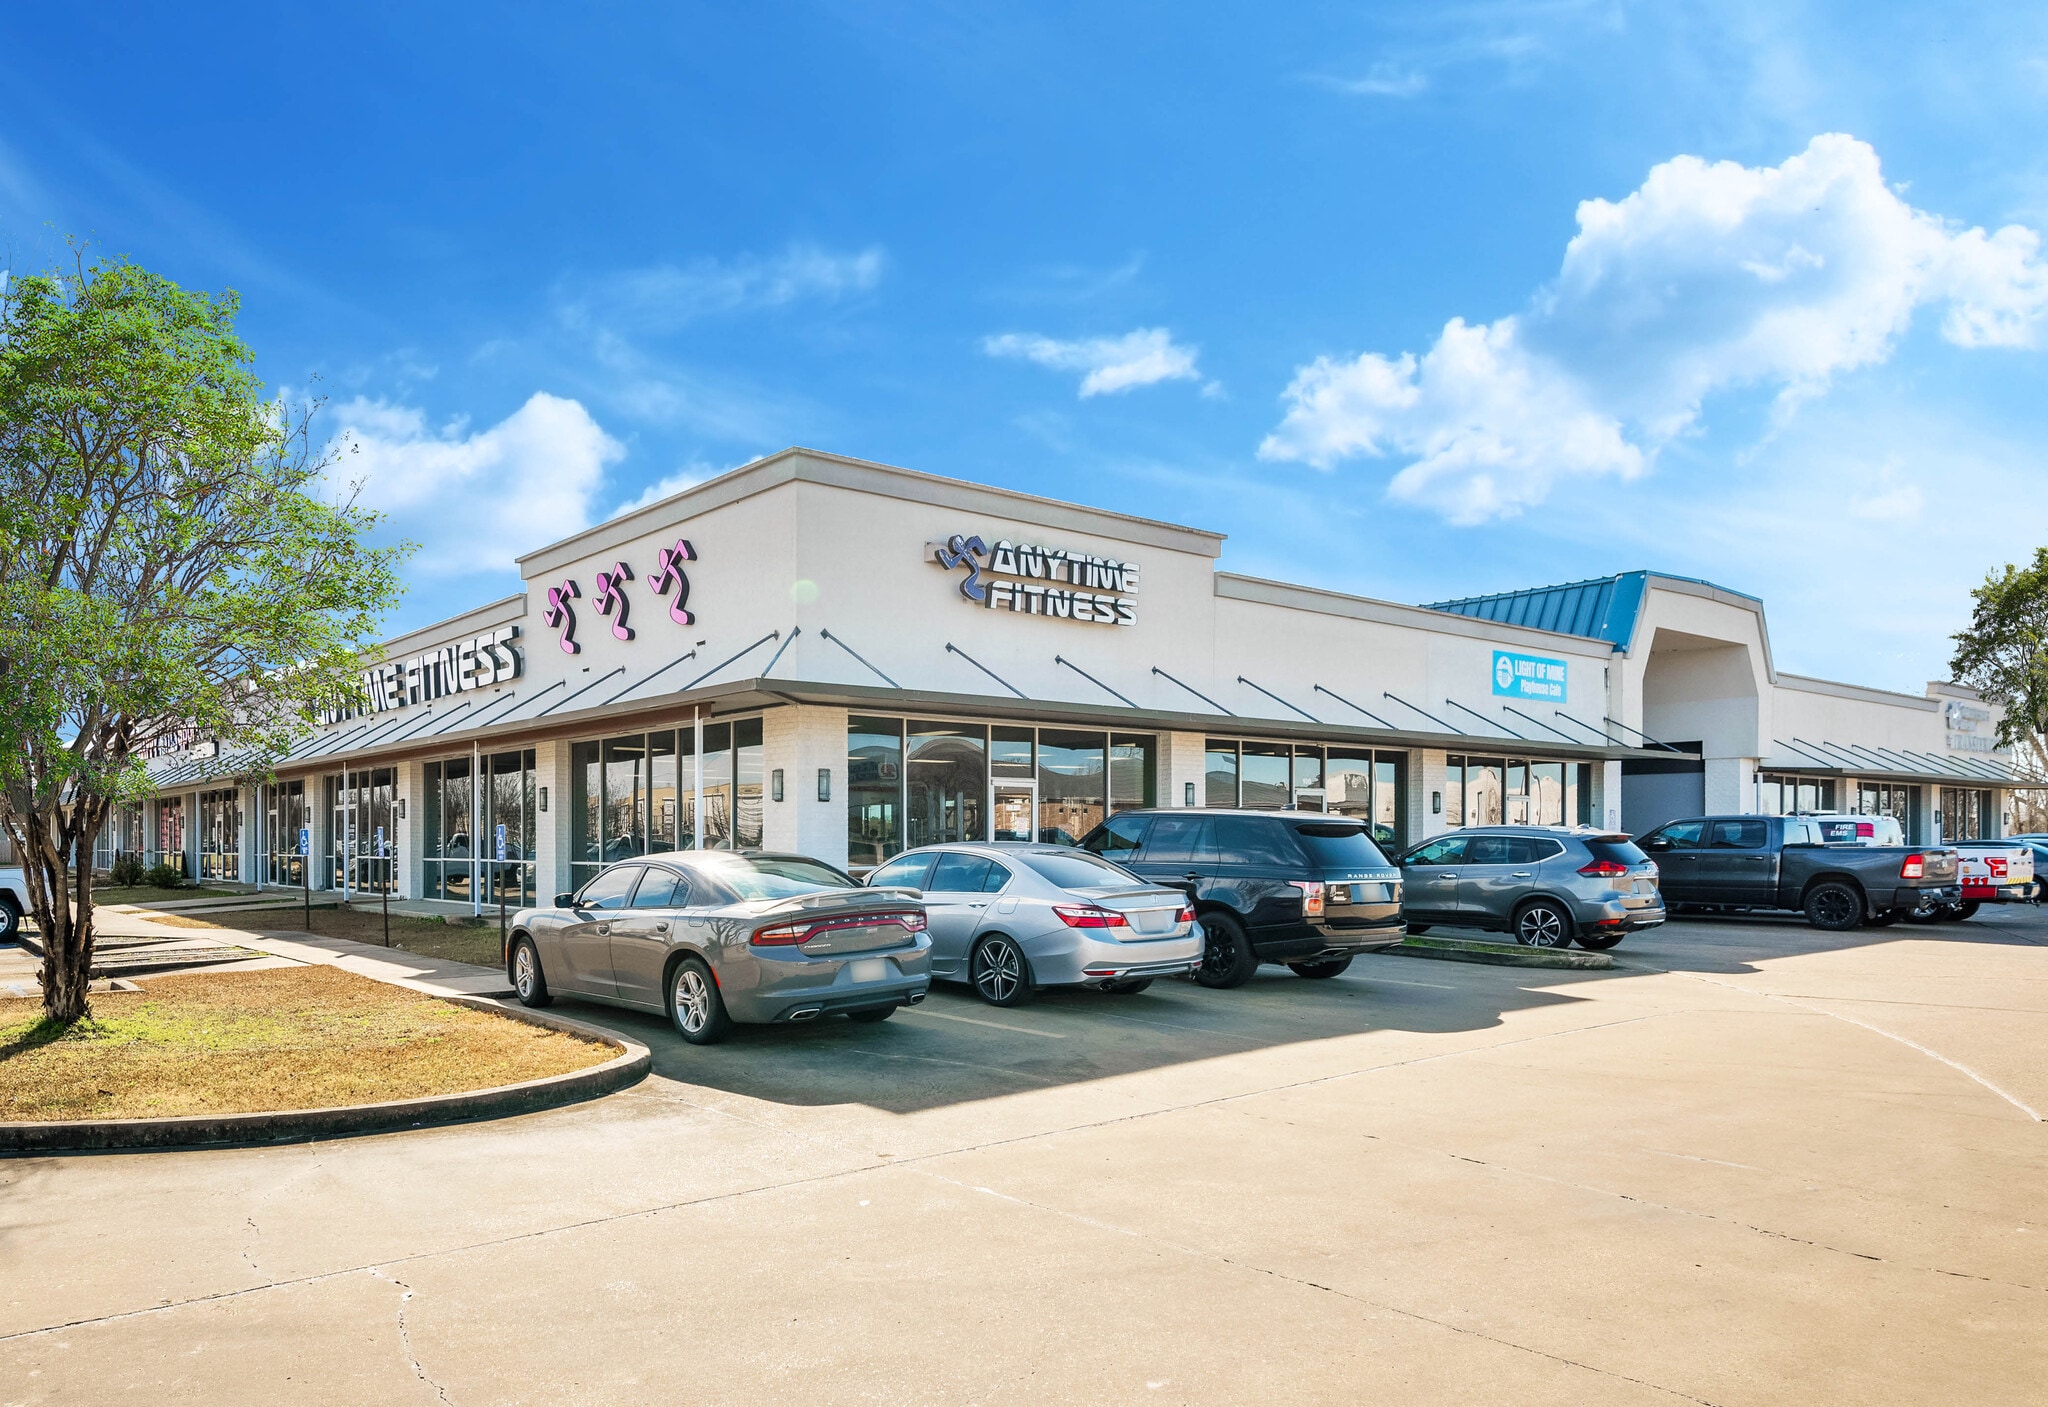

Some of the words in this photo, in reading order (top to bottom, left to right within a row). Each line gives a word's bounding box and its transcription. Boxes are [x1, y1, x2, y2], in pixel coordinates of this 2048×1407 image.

[988, 539, 1140, 594] ANYTIME
[985, 580, 1138, 626] FITNESS
[404, 626, 519, 706] FITNESS
[1515, 659, 1536, 678] LIGHT
[1536, 662, 1546, 679] OF
[1547, 664, 1565, 682] MINE
[829, 916, 889, 924] DODGE
